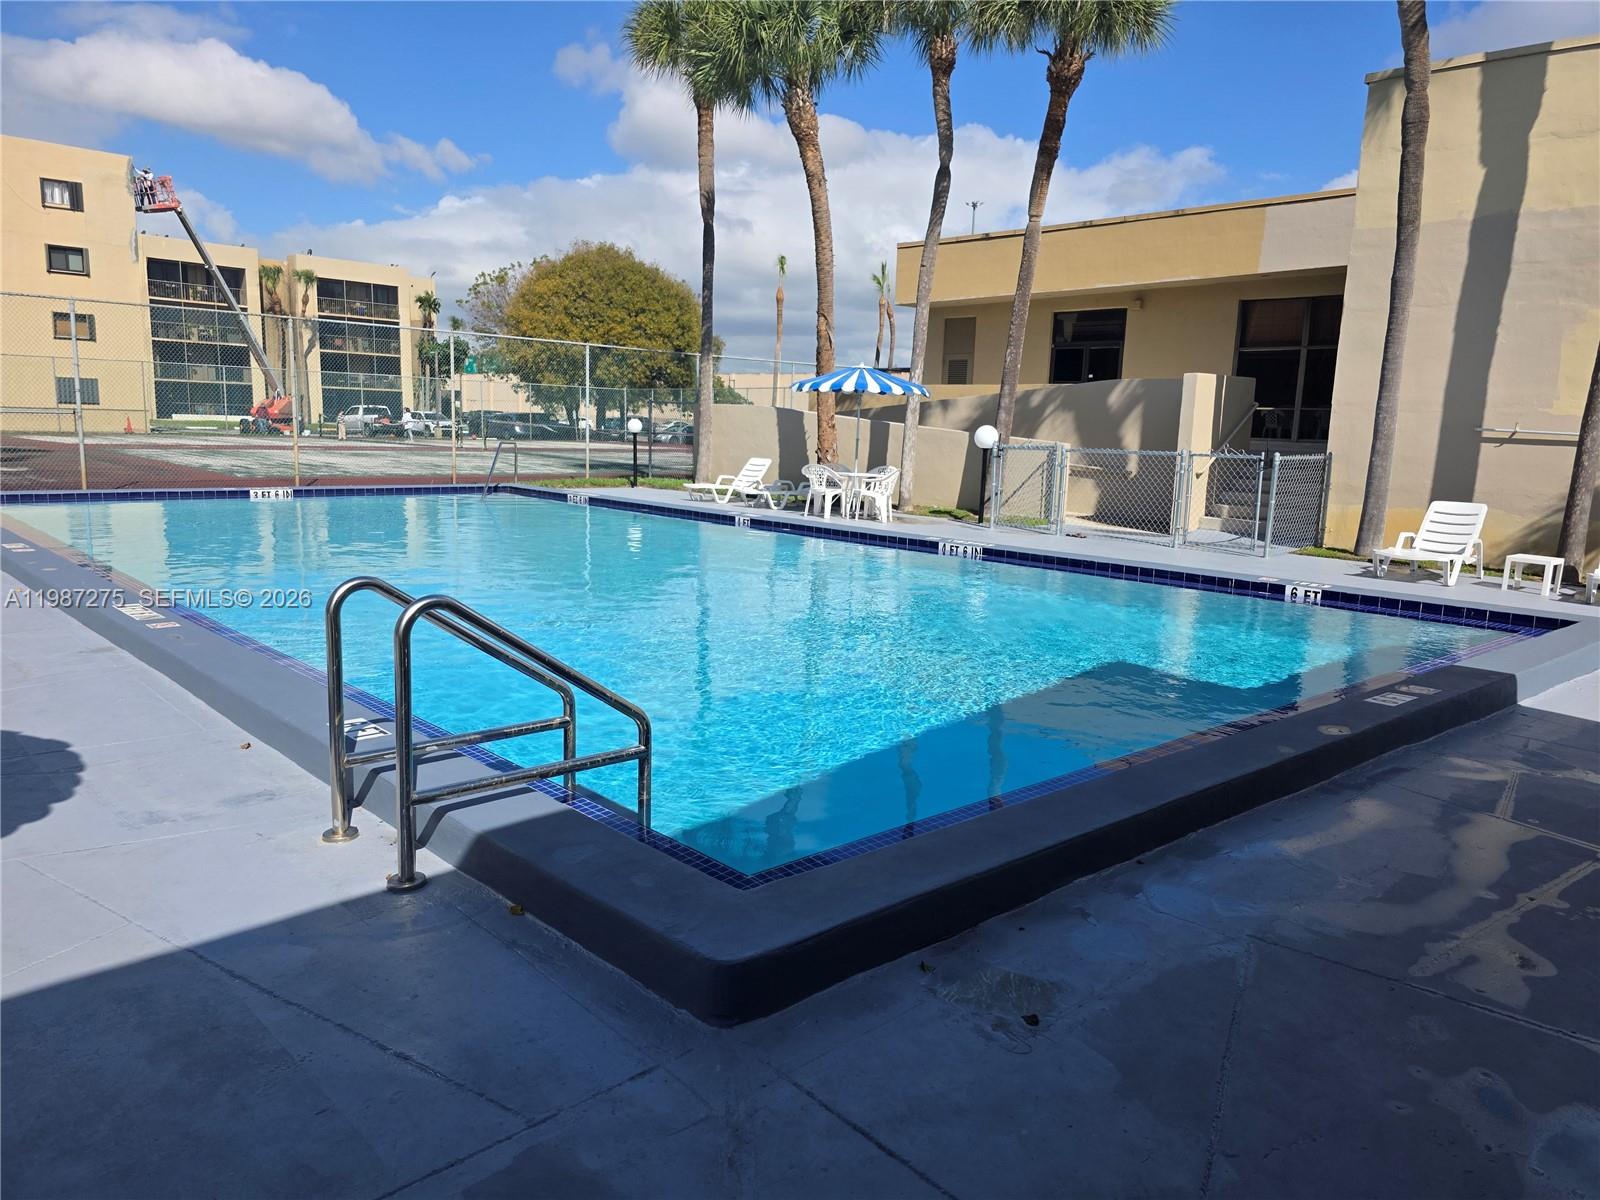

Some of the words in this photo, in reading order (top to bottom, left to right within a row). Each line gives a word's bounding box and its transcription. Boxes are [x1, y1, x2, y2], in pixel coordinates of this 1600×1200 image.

[942, 543, 947, 555] 4
[950, 545, 960, 556] FT
[963, 546, 968, 558] 6
[971, 547, 982, 560] IN
[1290, 587, 1298, 603] 6
[1303, 590, 1321, 605] FT
